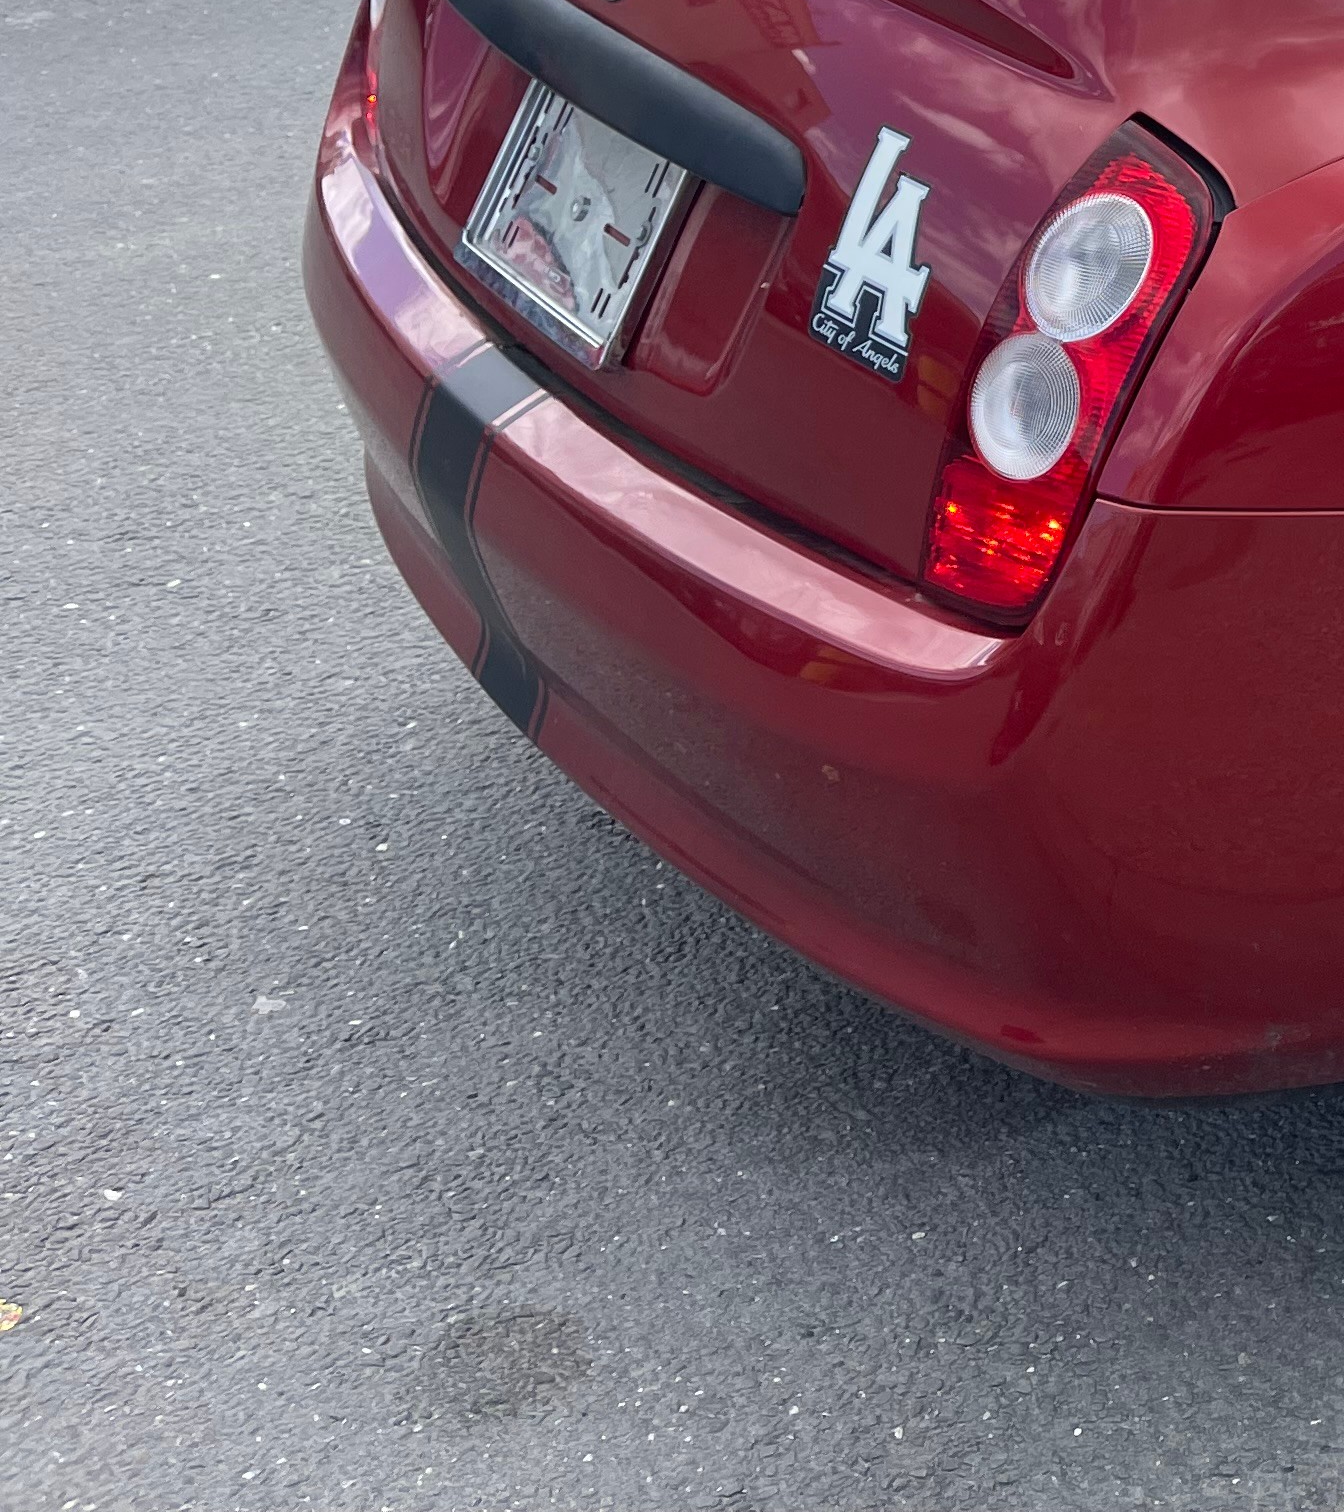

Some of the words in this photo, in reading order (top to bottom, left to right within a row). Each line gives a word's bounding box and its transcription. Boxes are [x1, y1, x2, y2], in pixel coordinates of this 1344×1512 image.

[826, 126, 931, 349] LA
[812, 312, 839, 344] City
[838, 331, 855, 351] of
[852, 339, 899, 374] Angels
